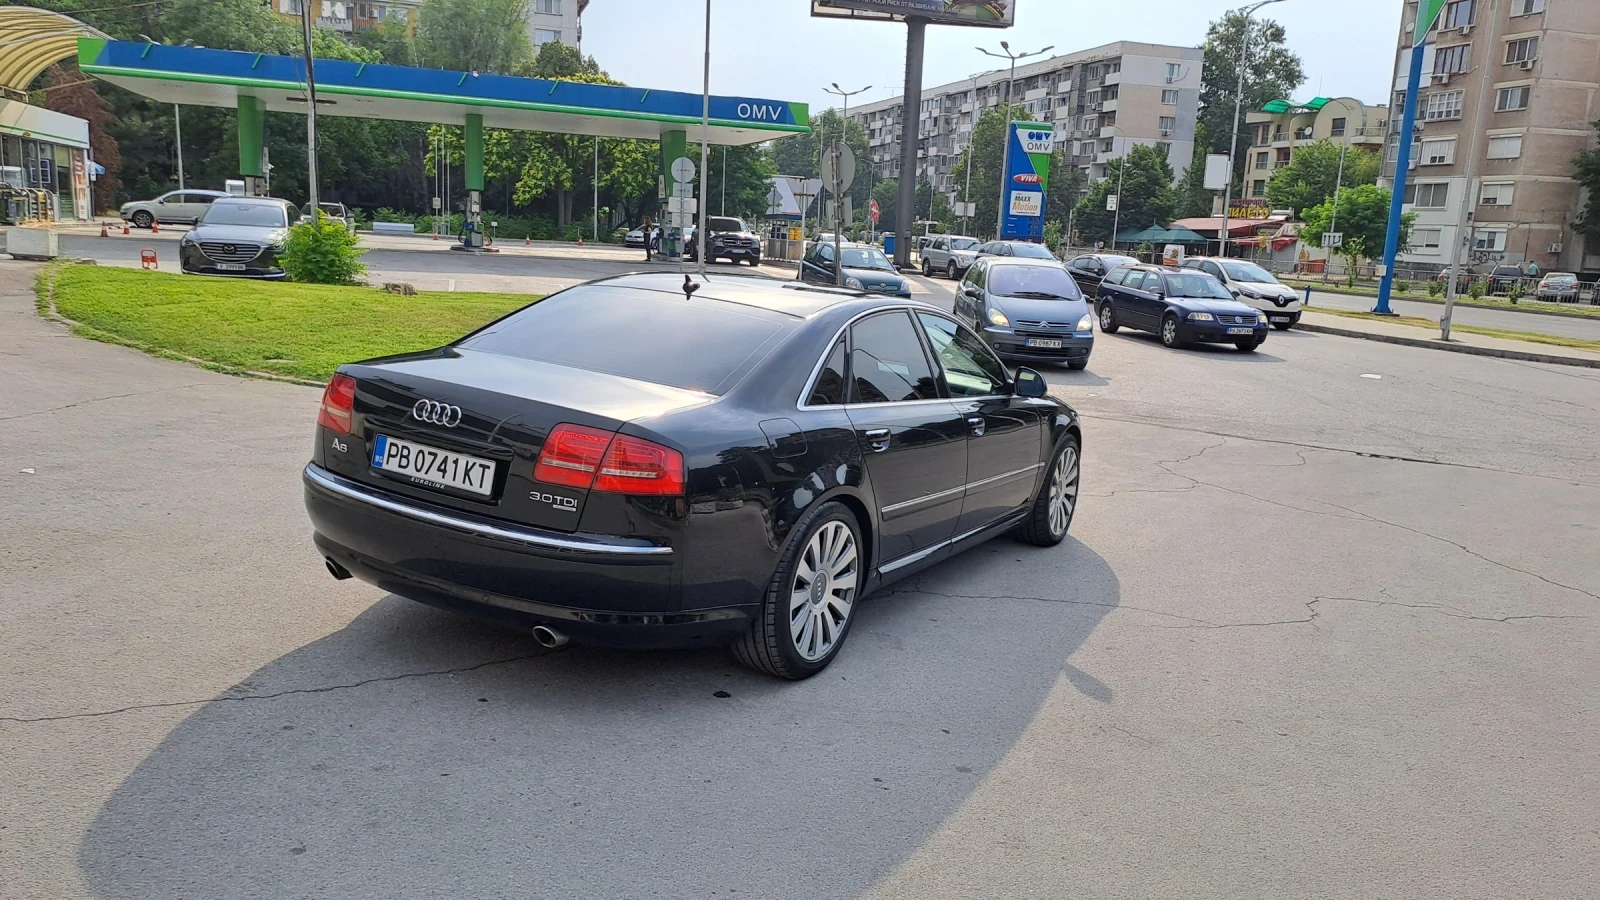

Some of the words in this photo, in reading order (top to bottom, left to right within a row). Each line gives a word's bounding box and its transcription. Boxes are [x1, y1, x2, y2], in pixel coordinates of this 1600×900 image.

[737, 103, 782, 121] OMV
[1027, 142, 1050, 151] OMV
[1012, 202, 1038, 212] Motion
[331, 437, 348, 453] A8
[375, 455, 383, 463] BG
[385, 442, 411, 469] PB
[414, 449, 459, 482] 0741
[462, 460, 491, 489] KT
[410, 476, 446, 490] EUROLINK
